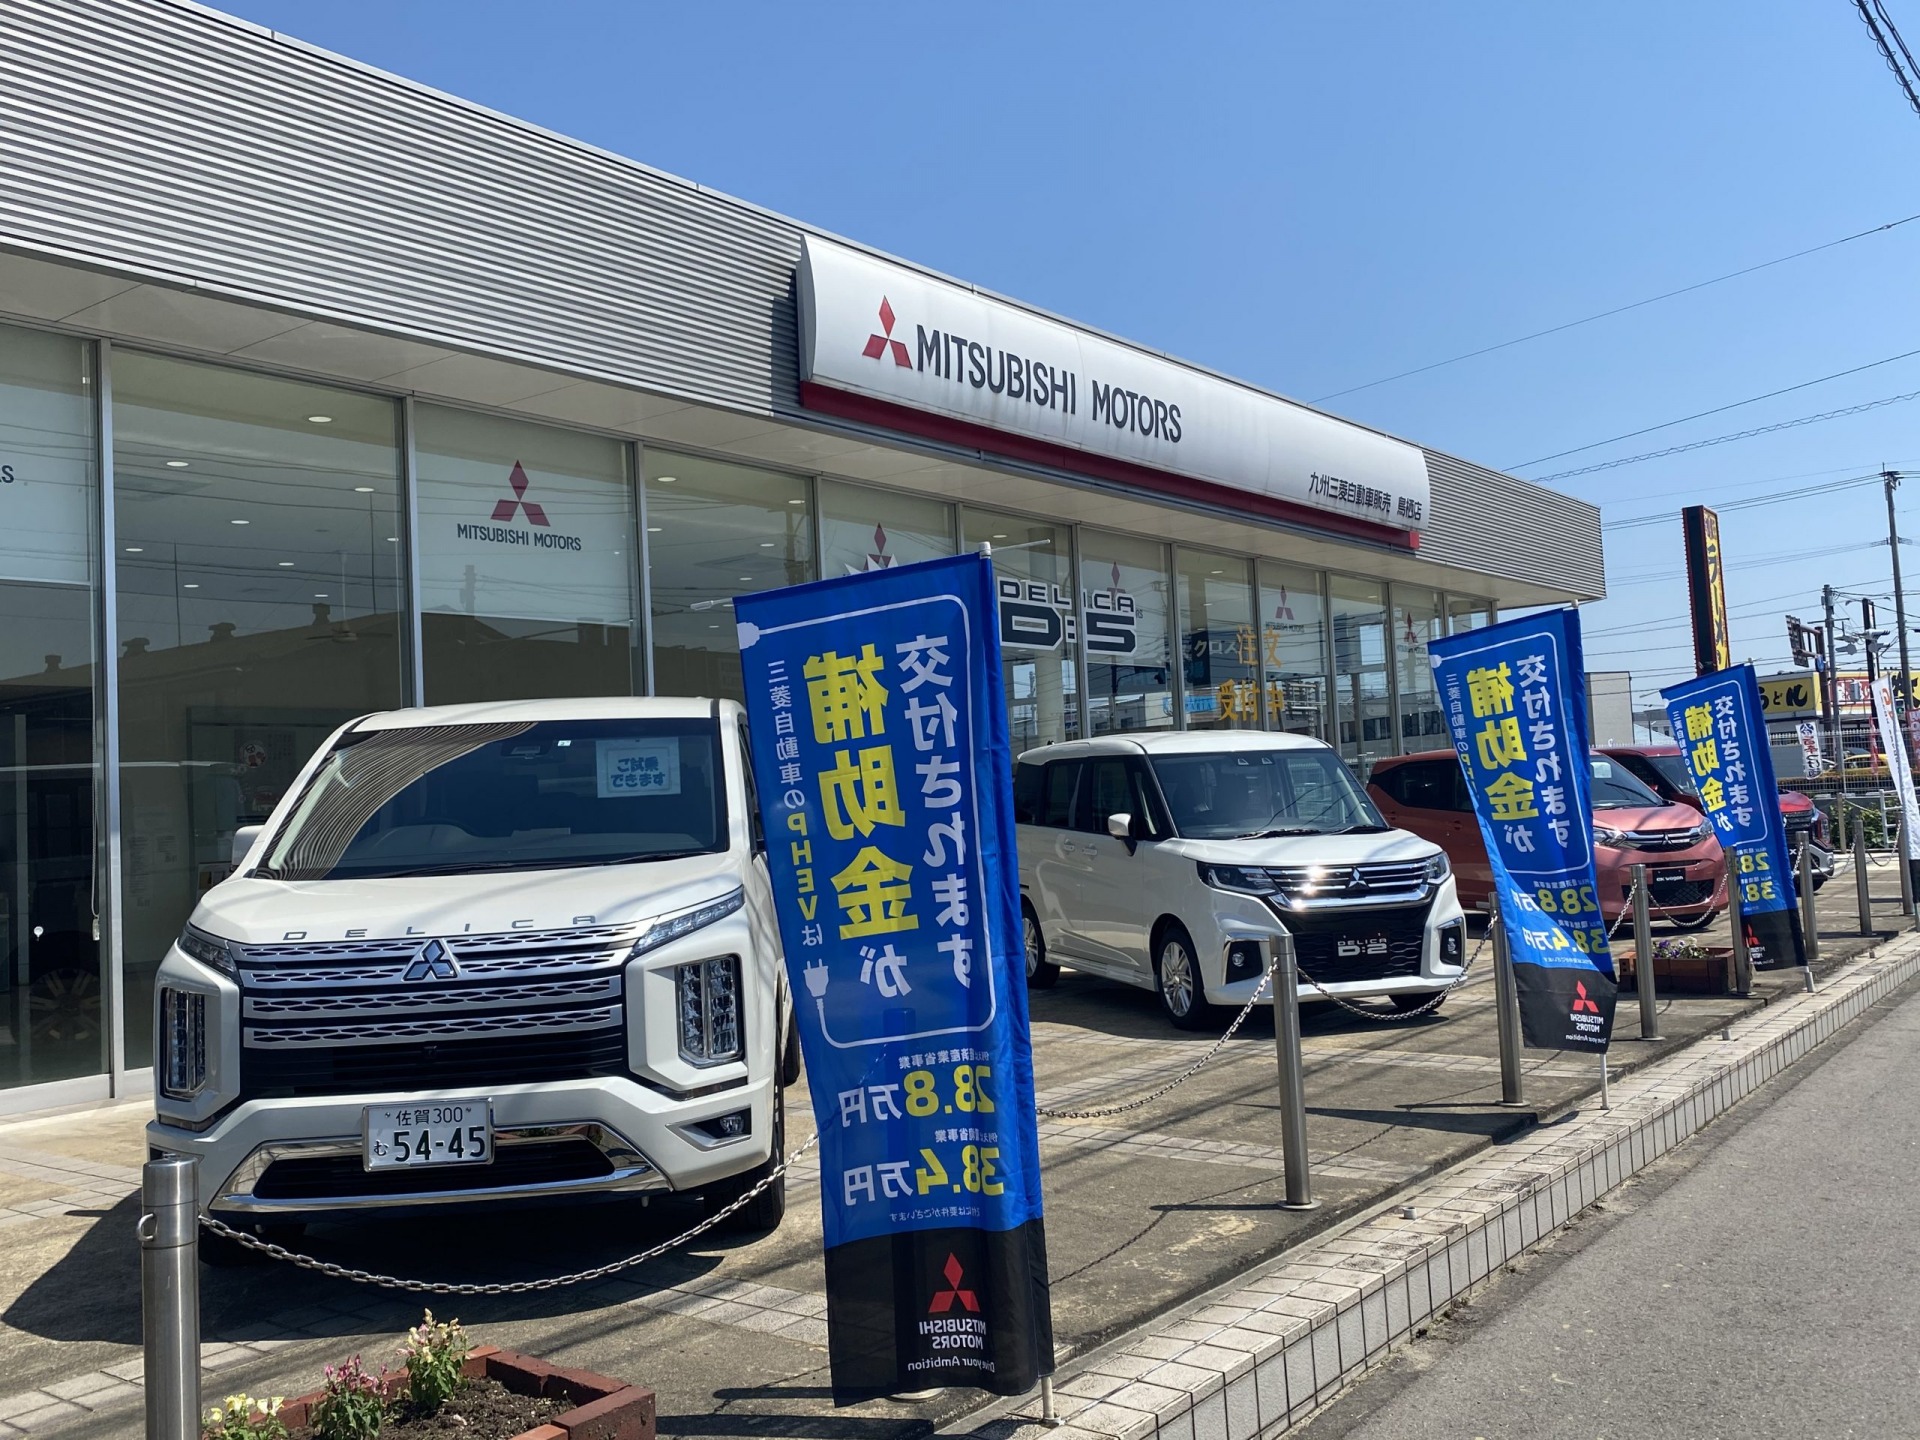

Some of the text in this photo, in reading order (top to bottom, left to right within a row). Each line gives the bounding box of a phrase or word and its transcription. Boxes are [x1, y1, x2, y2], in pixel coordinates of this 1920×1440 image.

[916, 323, 1182, 444] MITSUBISHI MOTORS
[1308, 471, 1423, 521] 九州三菱自動車販売 鳥栖店
[456, 523, 582, 551] MITSUBISHI MOTORS
[999, 579, 1135, 613] DELICA
[999, 600, 1136, 654] D:5
[1236, 624, 1282, 668] 注文
[611, 771, 666, 788] できます
[283, 914, 597, 941] DELICA
[1337, 938, 1388, 946] DELICA
[1337, 943, 1388, 957] D:2
[395, 1106, 463, 1127] 佐賀 300
[373, 1125, 486, 1162] む 54-45
